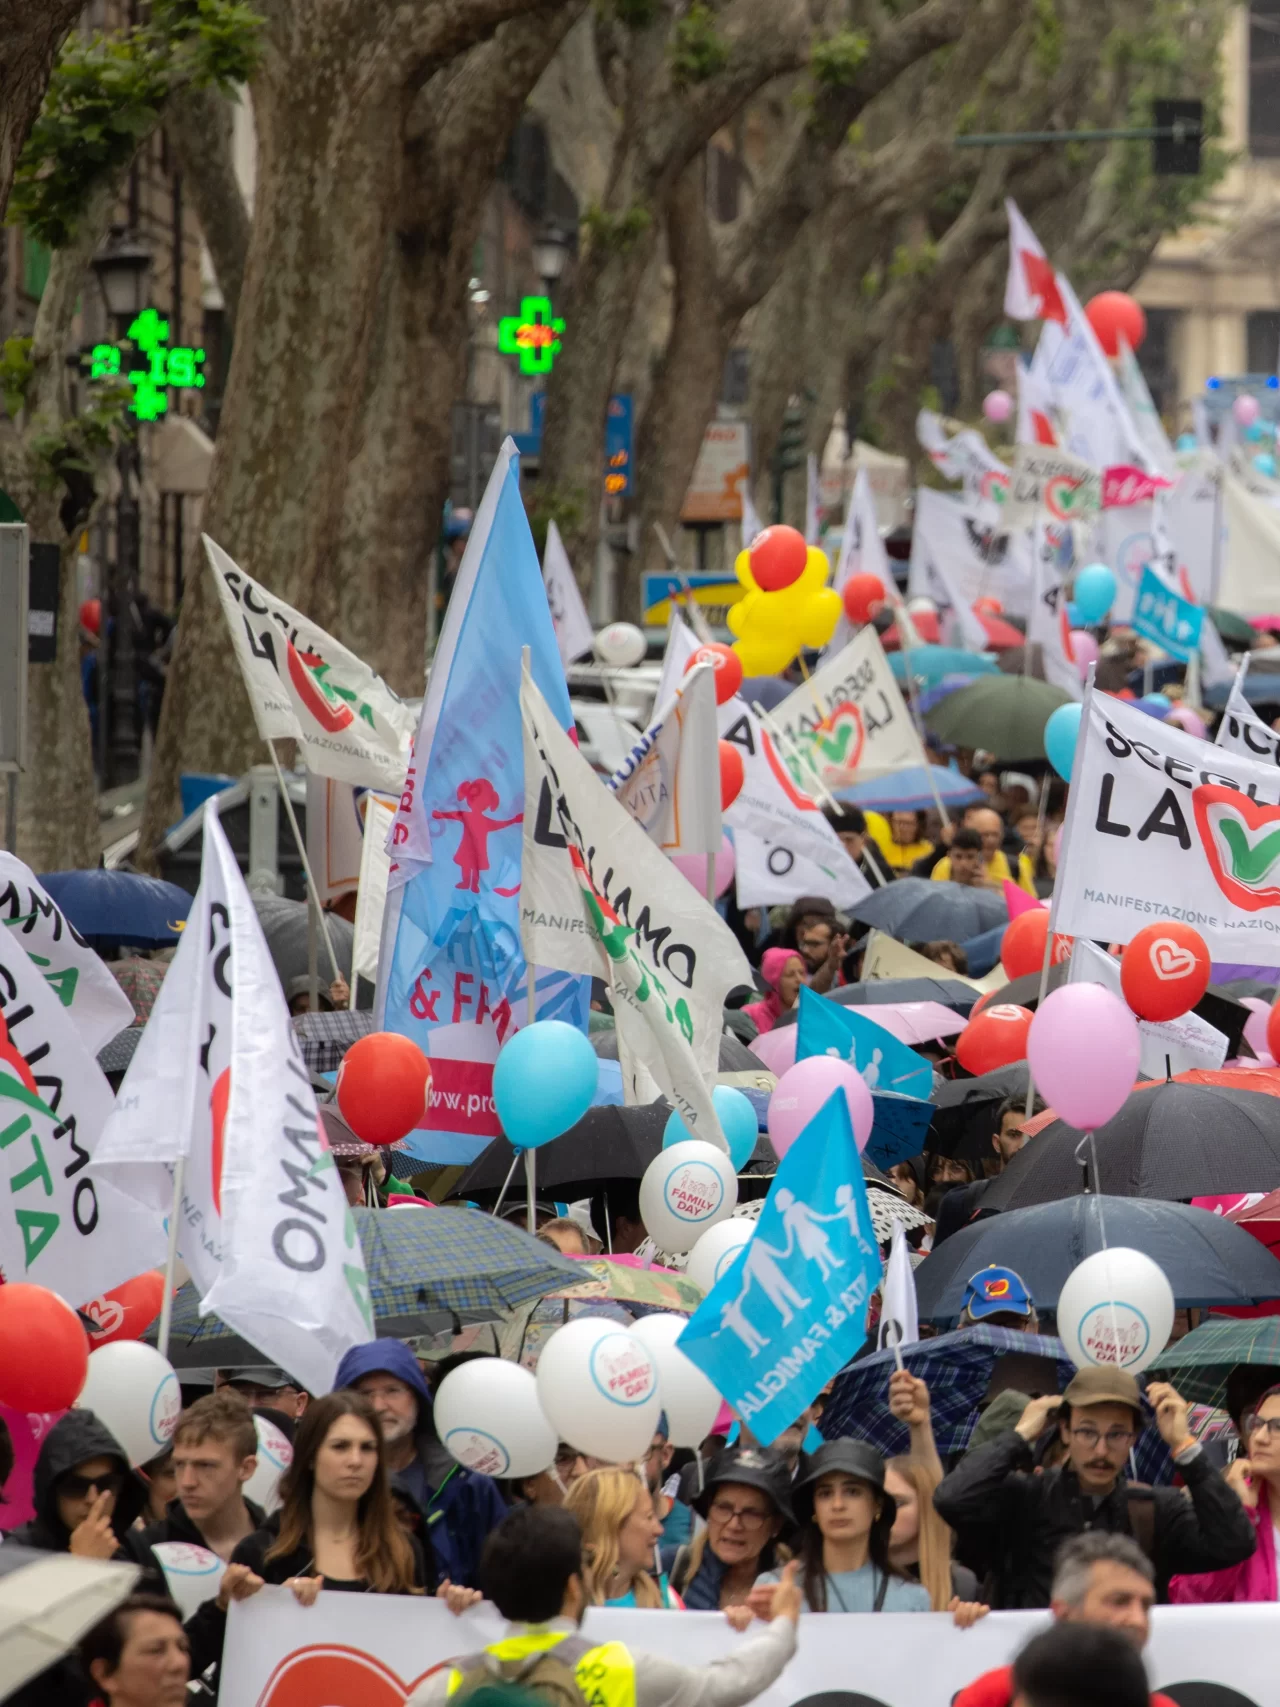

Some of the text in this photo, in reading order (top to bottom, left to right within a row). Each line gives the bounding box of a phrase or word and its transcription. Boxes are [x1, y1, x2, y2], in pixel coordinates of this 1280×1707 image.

[303, 732, 372, 760] NAZIONALE
[1095, 773, 1192, 850] LA
[1083, 888, 1218, 928] MANIFESTAZIONE
[671, 1188, 714, 1211] FAMILY
[677, 1201, 703, 1217] DAY
[1087, 1338, 1141, 1354] FAMILY
